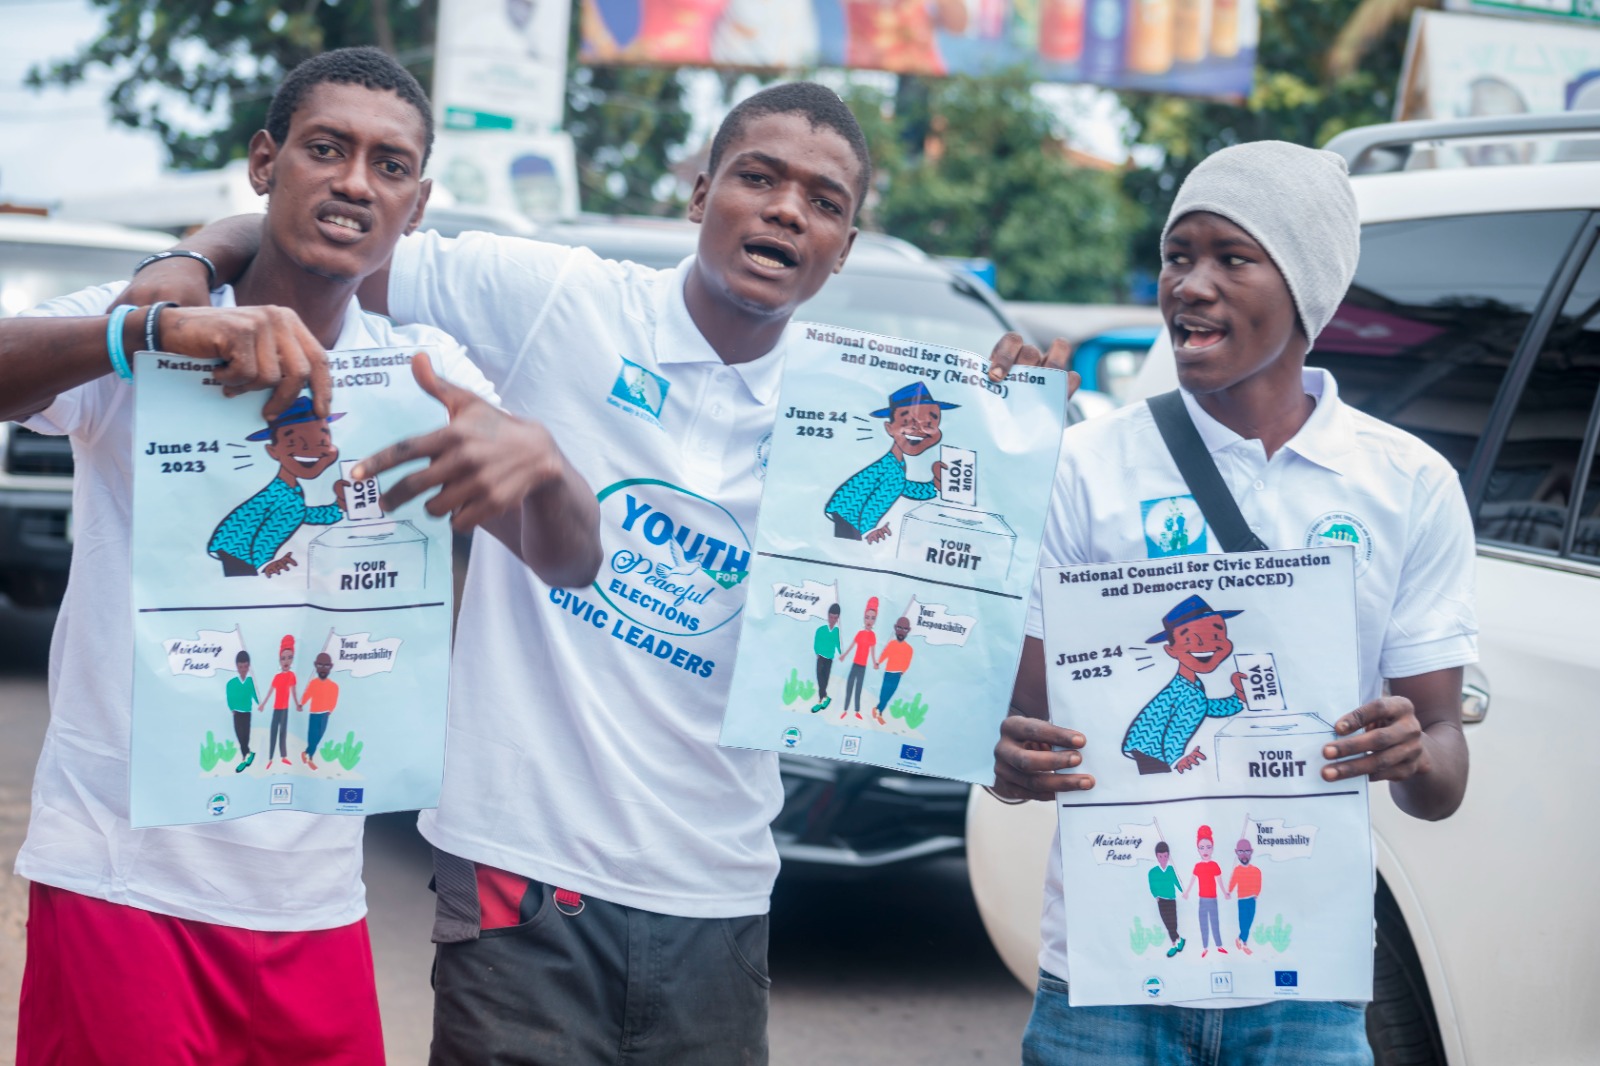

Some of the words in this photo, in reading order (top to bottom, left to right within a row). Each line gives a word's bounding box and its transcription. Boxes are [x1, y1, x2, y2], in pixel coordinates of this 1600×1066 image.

[157, 359, 220, 372] Nation
[352, 353, 412, 369] Educatio
[806, 328, 864, 349] National
[868, 338, 918, 359] Council
[921, 348, 941, 363] for
[944, 353, 979, 370] Civic
[981, 363, 1046, 385] Ecation
[841, 352, 866, 366] and
[869, 355, 940, 380] Democracy
[785, 406, 825, 421] June
[828, 411, 848, 424] 24
[796, 424, 834, 439] 2023
[145, 442, 192, 456] June
[196, 440, 220, 454] 24
[161, 460, 206, 473] 2023
[949, 459, 962, 493] VOTE
[962, 463, 973, 492] YOUR
[353, 480, 366, 509] OTE
[366, 479, 377, 504] OUR
[621, 494, 751, 572] YOUTH
[940, 538, 971, 553] YOUR
[353, 561, 386, 572] YOUR
[926, 547, 981, 571] RIGHT
[715, 571, 739, 584] FOR
[1059, 567, 1124, 584] National
[1127, 561, 1184, 579] Council
[1187, 560, 1209, 574] for
[1213, 557, 1251, 571] Civic
[1255, 553, 1331, 569] Education
[340, 571, 399, 590] RIGHT
[611, 550, 715, 607] Peaceful
[1101, 584, 1129, 597] and
[1132, 577, 1213, 596] Democracy
[1218, 571, 1294, 590] (NaCCED)
[775, 585, 821, 605] Maintaining
[609, 578, 700, 632] ELECTIONS
[783, 601, 807, 615] Peace
[919, 605, 936, 618] Your
[549, 586, 608, 629] CIVIC
[611, 619, 715, 679] LEADERS
[917, 616, 968, 636] Responsibility
[169, 642, 223, 657] Maintaining
[340, 638, 358, 649] Your
[339, 648, 393, 661] Responsibility
[1056, 650, 1098, 666] June
[1102, 645, 1123, 659] 24
[182, 659, 210, 671] Peace
[1071, 665, 1112, 681] 2023
[1248, 665, 1266, 702] VOTE
[1263, 666, 1278, 697] YOUR
[1259, 750, 1293, 761] YOUR
[1249, 761, 1307, 778] RIGHT
[1256, 823, 1273, 835] Your
[1092, 834, 1142, 849] Maintaining
[1257, 834, 1310, 847] Responsibility
[1106, 850, 1132, 861] Peace
